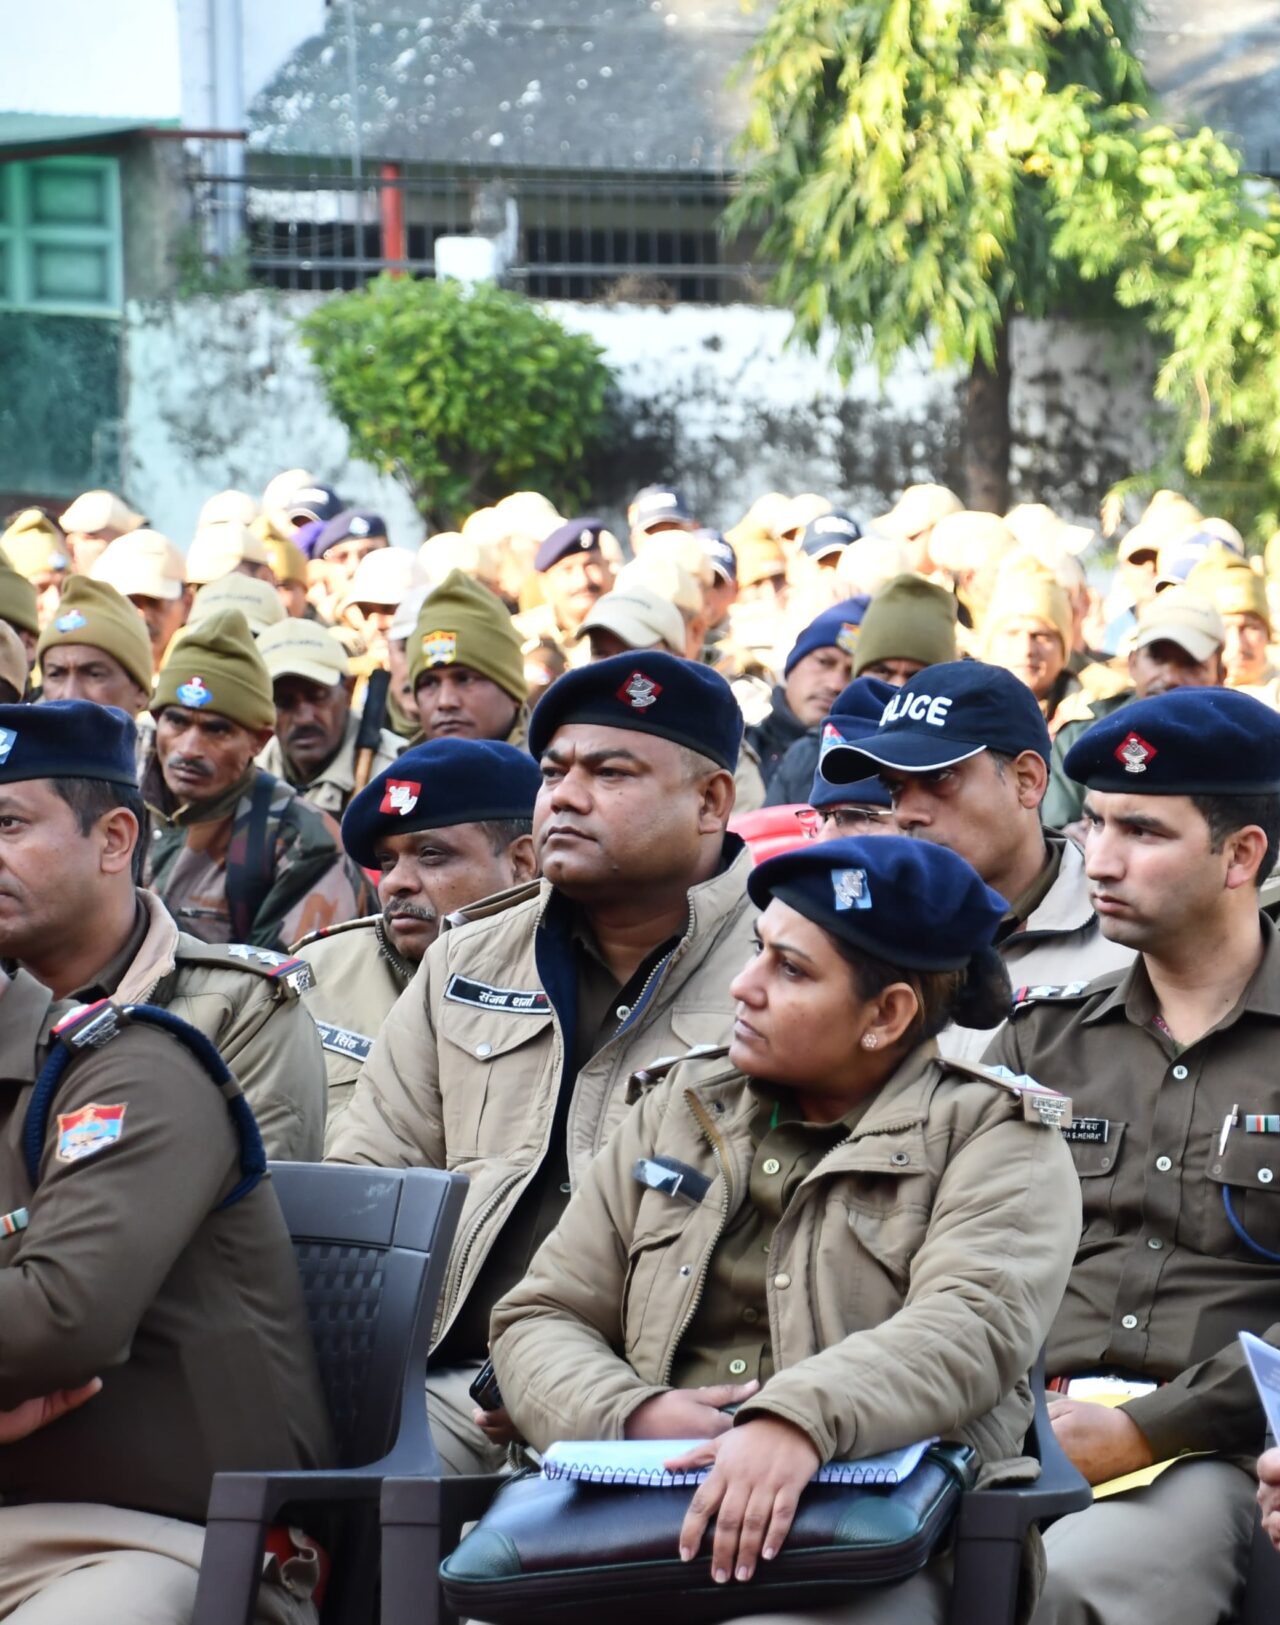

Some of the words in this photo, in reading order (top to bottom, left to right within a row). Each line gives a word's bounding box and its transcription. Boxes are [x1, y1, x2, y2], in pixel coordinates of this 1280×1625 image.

[478, 991, 509, 1006] संजय
[512, 994, 537, 1007] शर्मा
[333, 1031, 359, 1050] सिंह
